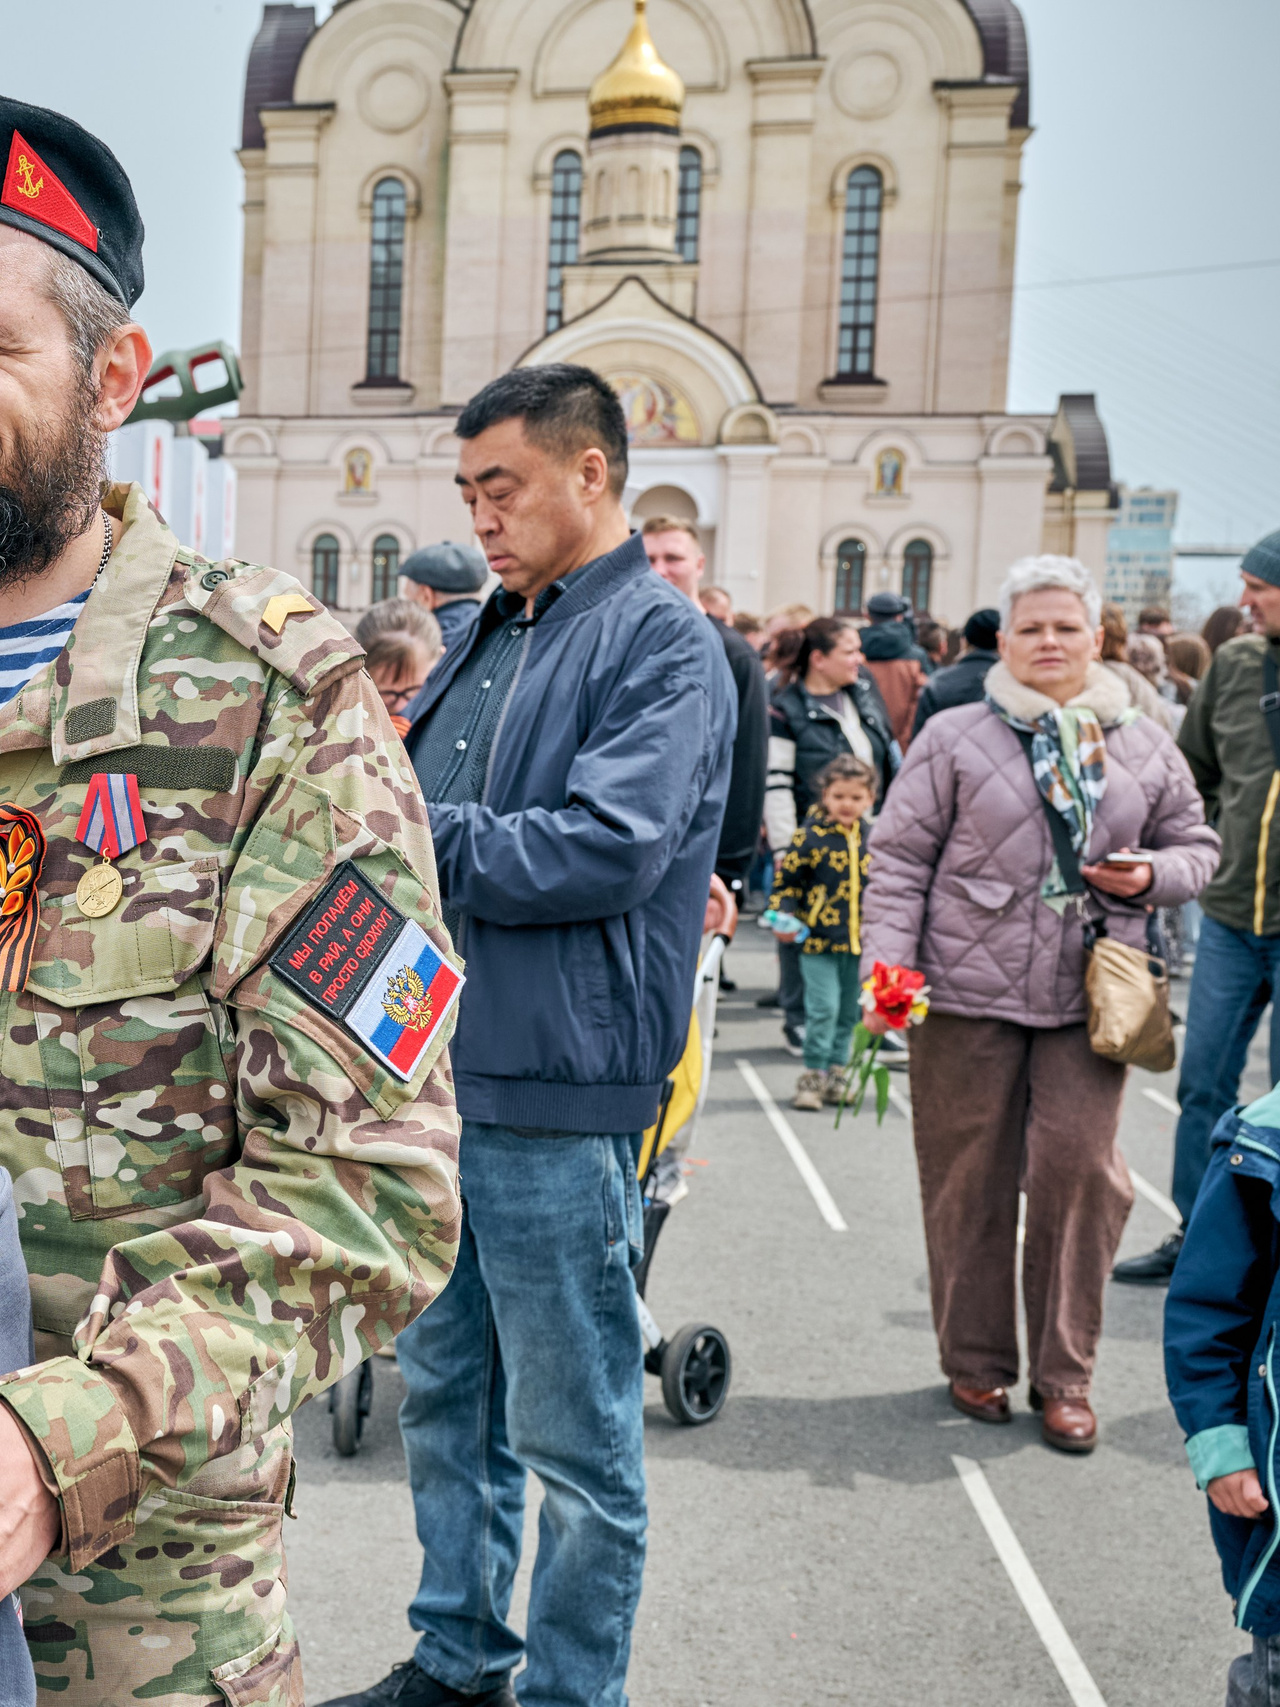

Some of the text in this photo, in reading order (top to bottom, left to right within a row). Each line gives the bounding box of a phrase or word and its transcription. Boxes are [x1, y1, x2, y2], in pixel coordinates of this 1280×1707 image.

[288, 880, 359, 970] МЫ ПОПАДЁМ
[308, 897, 375, 985] В РАЙ, А ОНИ
[321, 907, 393, 1005] ПРОСТО СДОХНУТ
